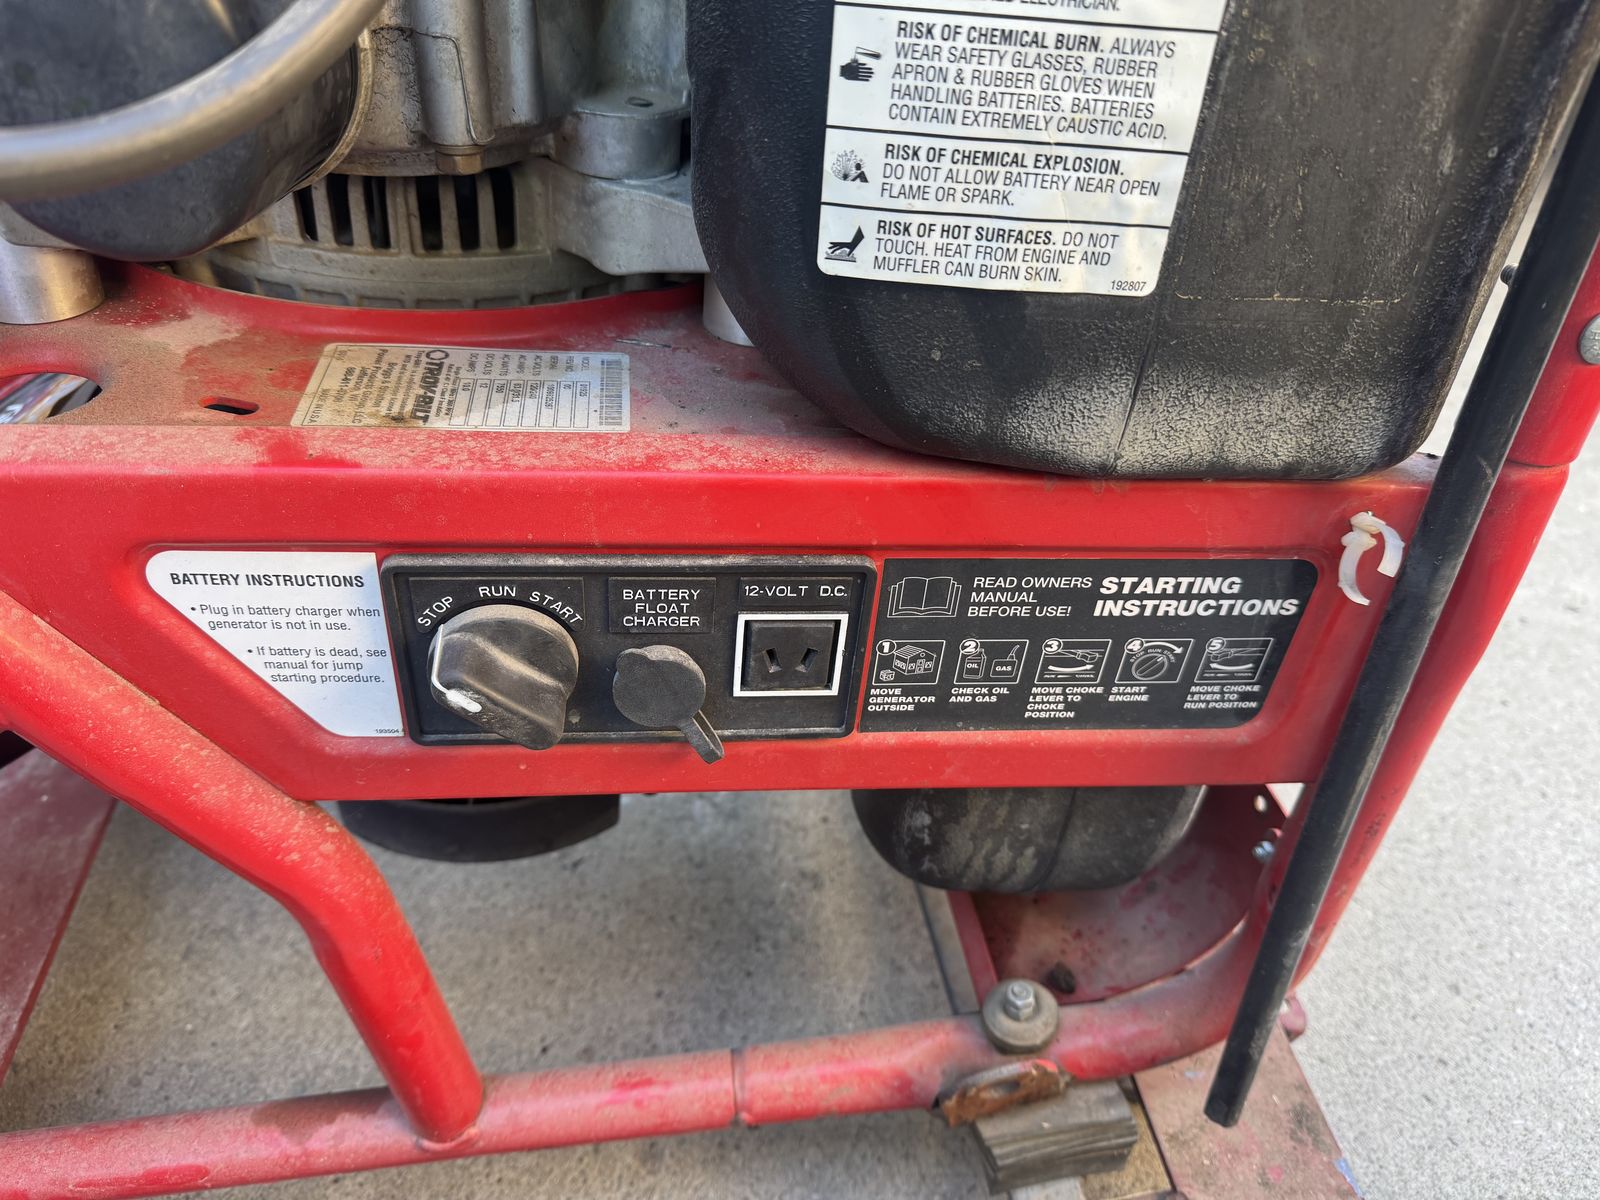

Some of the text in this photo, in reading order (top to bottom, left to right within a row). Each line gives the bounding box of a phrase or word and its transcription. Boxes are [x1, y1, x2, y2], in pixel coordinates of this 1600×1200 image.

[897, 20, 1176, 58] RISK OF CHEMICAL BURN. ALWAYS
[895, 41, 1158, 78] WEAR SAFETY GLASSES, RUBBER
[891, 62, 1155, 99] APRON & RUBBER GLOVES WHEN
[890, 83, 1155, 119] HANDLING BATTERIES. BATTERIES
[888, 103, 1167, 140] CONTAIN EXTREMELY CAUSTIC ACID.
[884, 143, 1124, 176] RISK OF CHEMICAL EXPLOSION.
[883, 163, 1160, 196] DO NOT ALLOW BATTERY NEAR OPEN
[881, 182, 1014, 206] FLAME OR SPARK.
[876, 219, 1120, 249] RISK OF HOT SURFACES. DO NOT
[875, 238, 1111, 266] TOUCH. HEAT FROM ENGINE AND
[873, 256, 1062, 282] MUFFLER CAN BURN SKIN.
[1111, 280, 1147, 291] 192807
[409, 360, 444, 422] TROY-BILT
[170, 573, 365, 588] BATTERY INSTRUCTIONS
[973, 577, 1092, 588] READ OWNERS
[1100, 577, 1241, 594] STARTING
[478, 586, 516, 597] RUN
[623, 589, 700, 600] BATTERY
[744, 585, 848, 597] 12-VOLT D.C.
[970, 592, 1037, 602] MANUAL
[200, 605, 380, 619] Plug in battery charger when
[417, 596, 453, 627] STOP
[529, 591, 583, 624] START
[635, 603, 690, 613] FLOAT
[967, 606, 1071, 617] BEFORE USE!
[1093, 599, 1299, 616] INSTRUCTIONS
[208, 619, 351, 631] generator is not in use.
[623, 616, 700, 627] CHARGER
[882, 642, 891, 652] 1
[964, 642, 977, 653] 2
[1045, 641, 1059, 652] 3
[1126, 640, 1141, 651] 4
[1209, 640, 1223, 651] 5
[256, 646, 387, 659] If battery is dead, see
[264, 659, 364, 672] manual for jump
[271, 673, 385, 684] starting procedure.
[1184, 701, 1257, 709] RUN POSITION
[1024, 710, 1075, 718] POSITION
